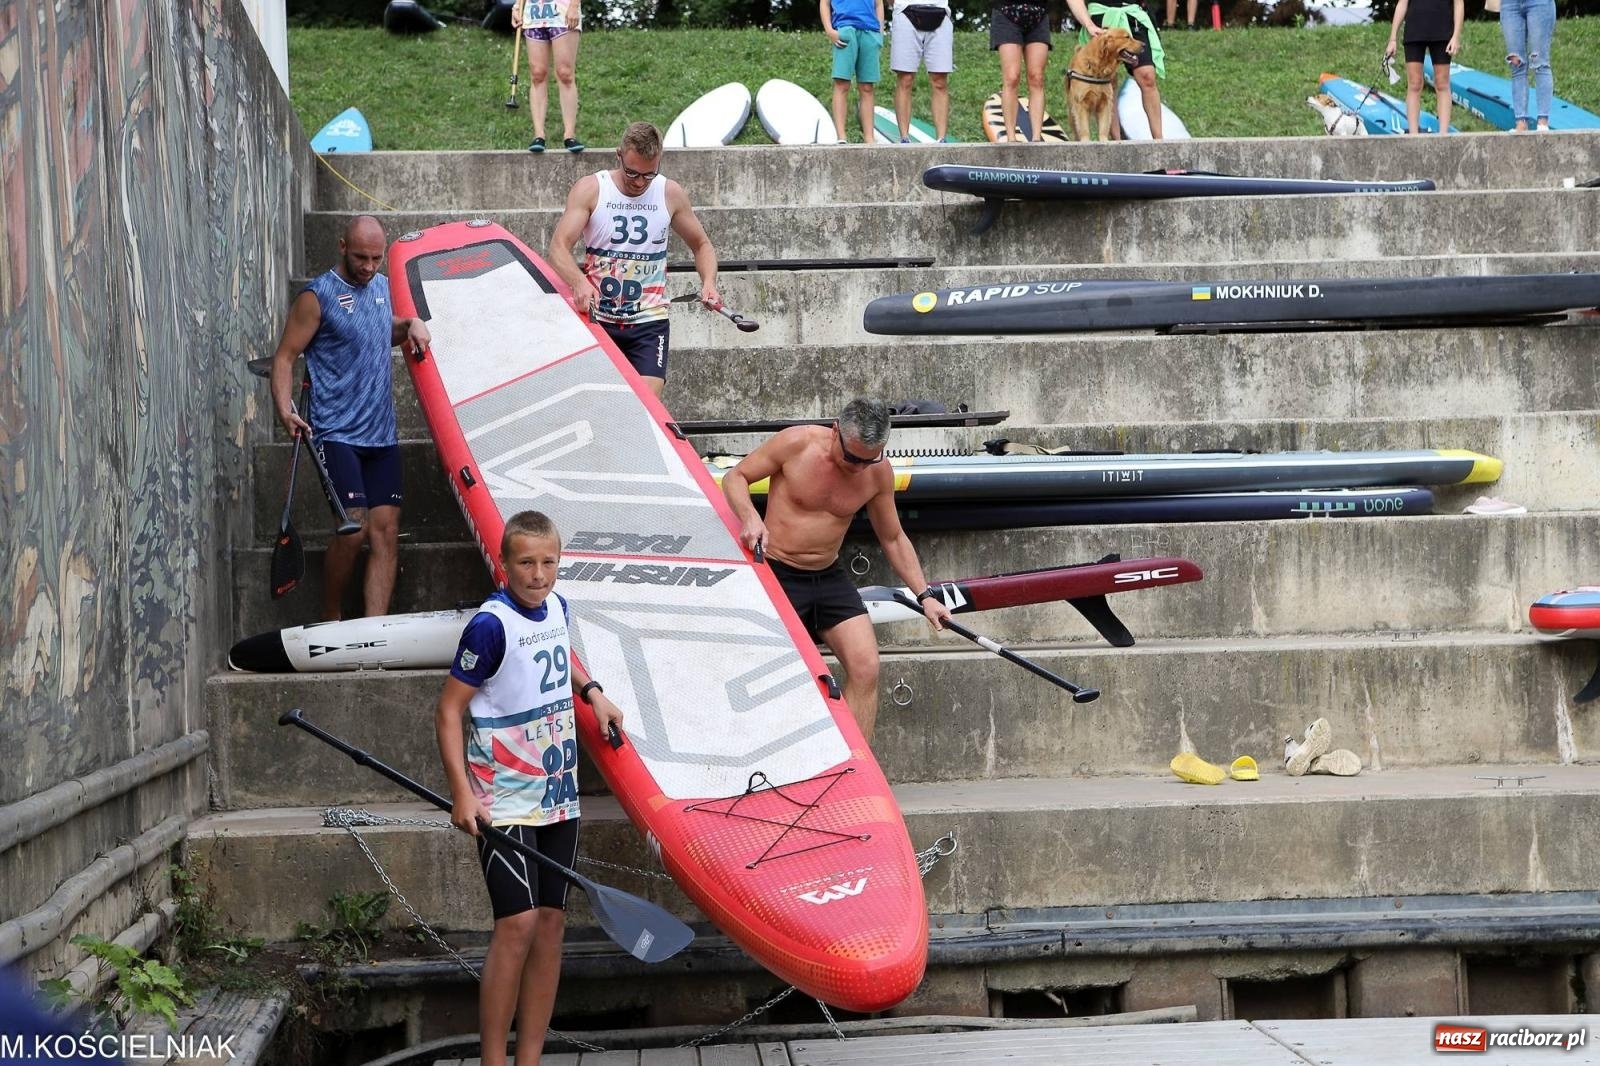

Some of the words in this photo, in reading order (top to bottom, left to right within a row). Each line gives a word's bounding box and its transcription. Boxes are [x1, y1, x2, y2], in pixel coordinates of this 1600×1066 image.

[968, 170, 1024, 184] CHAMPION
[606, 201, 658, 212] #odrasupcup
[610, 215, 648, 245] 33
[634, 264, 658, 275] SUP
[947, 285, 1029, 306] RAPID
[1033, 282, 1082, 295] SUP
[1216, 285, 1304, 299] MOKHNIUK
[1309, 285, 1324, 298] D.
[1103, 470, 1143, 482] ITIWIT
[565, 531, 692, 554] RACE
[1114, 567, 1178, 583] SIC
[533, 645, 569, 694] 29
